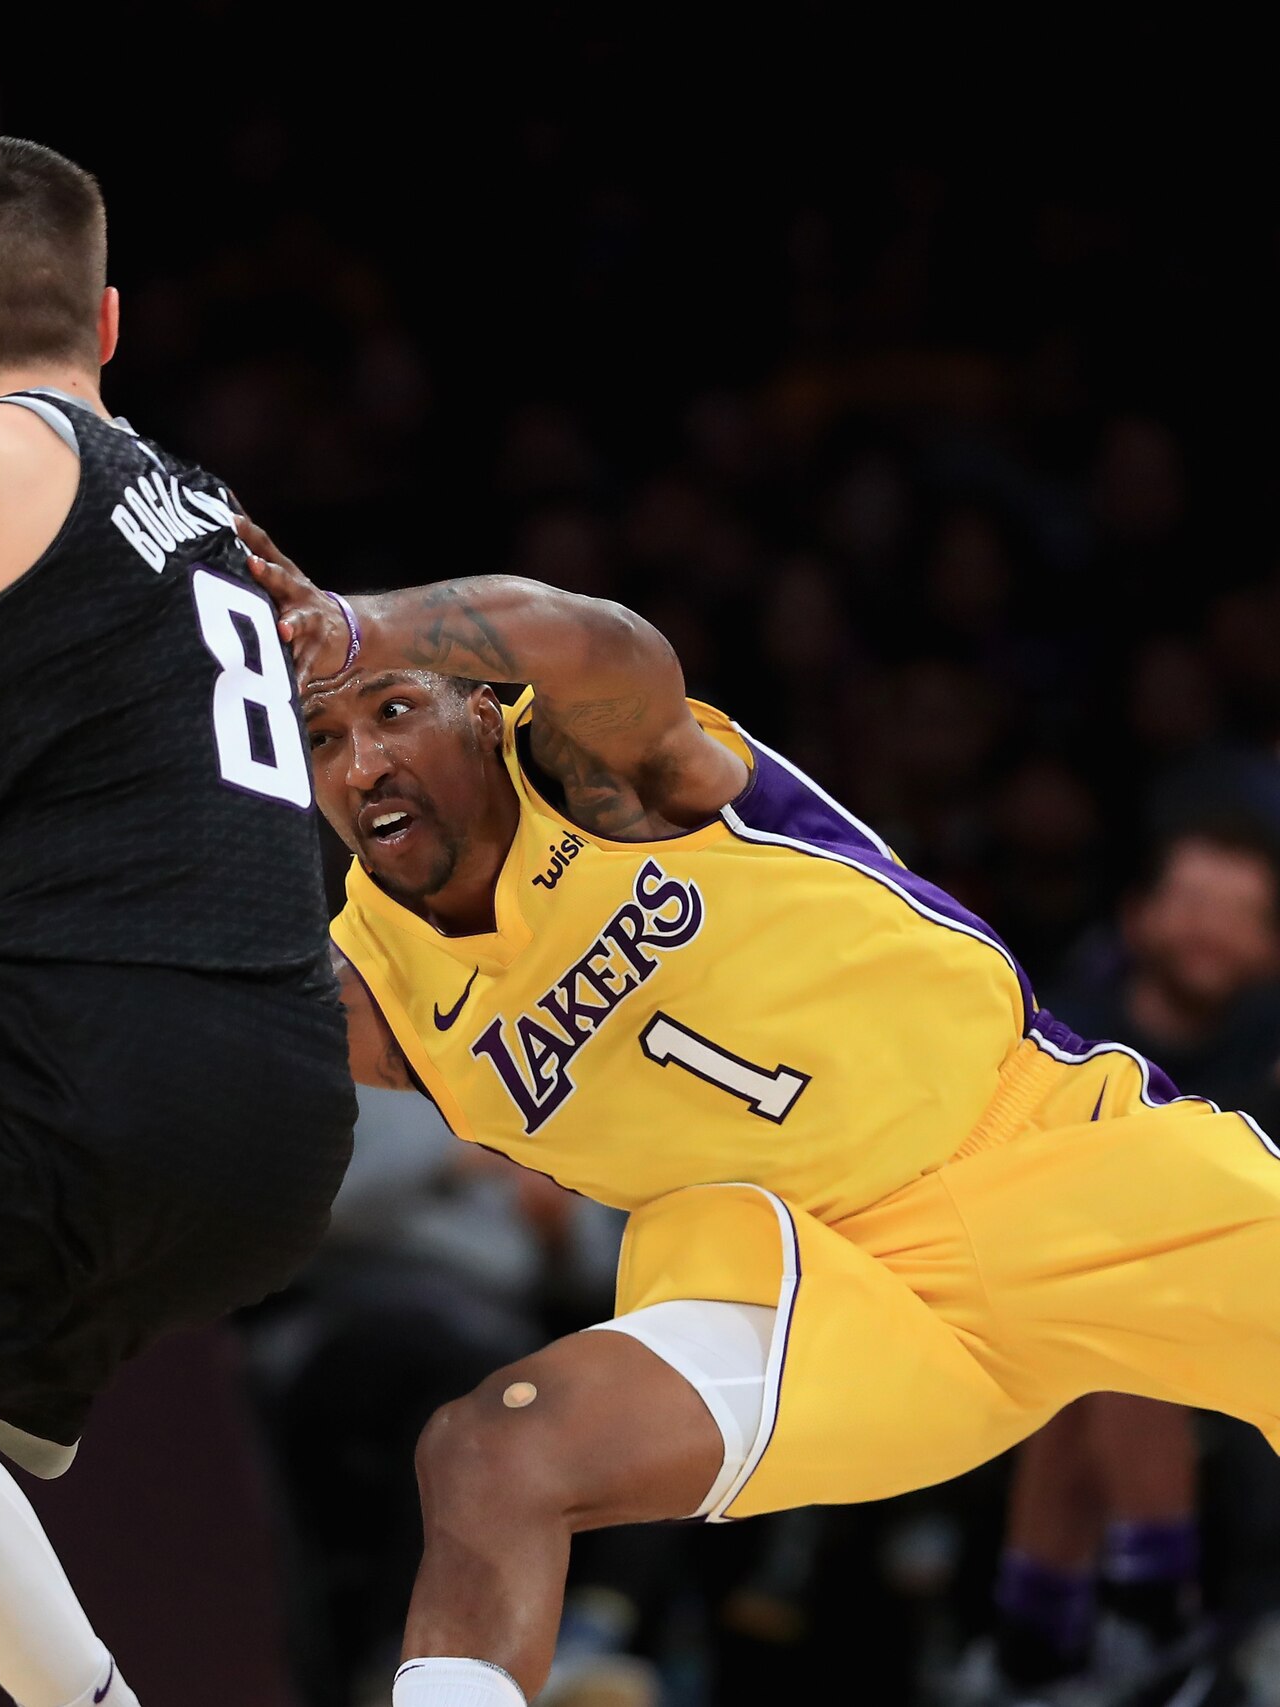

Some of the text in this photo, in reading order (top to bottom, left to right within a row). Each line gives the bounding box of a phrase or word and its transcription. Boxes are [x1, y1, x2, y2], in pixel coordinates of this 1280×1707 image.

[191, 565, 316, 813] 8
[531, 830, 590, 890] wish
[470, 856, 705, 1136] LAKERS
[638, 1011, 812, 1125] 1
